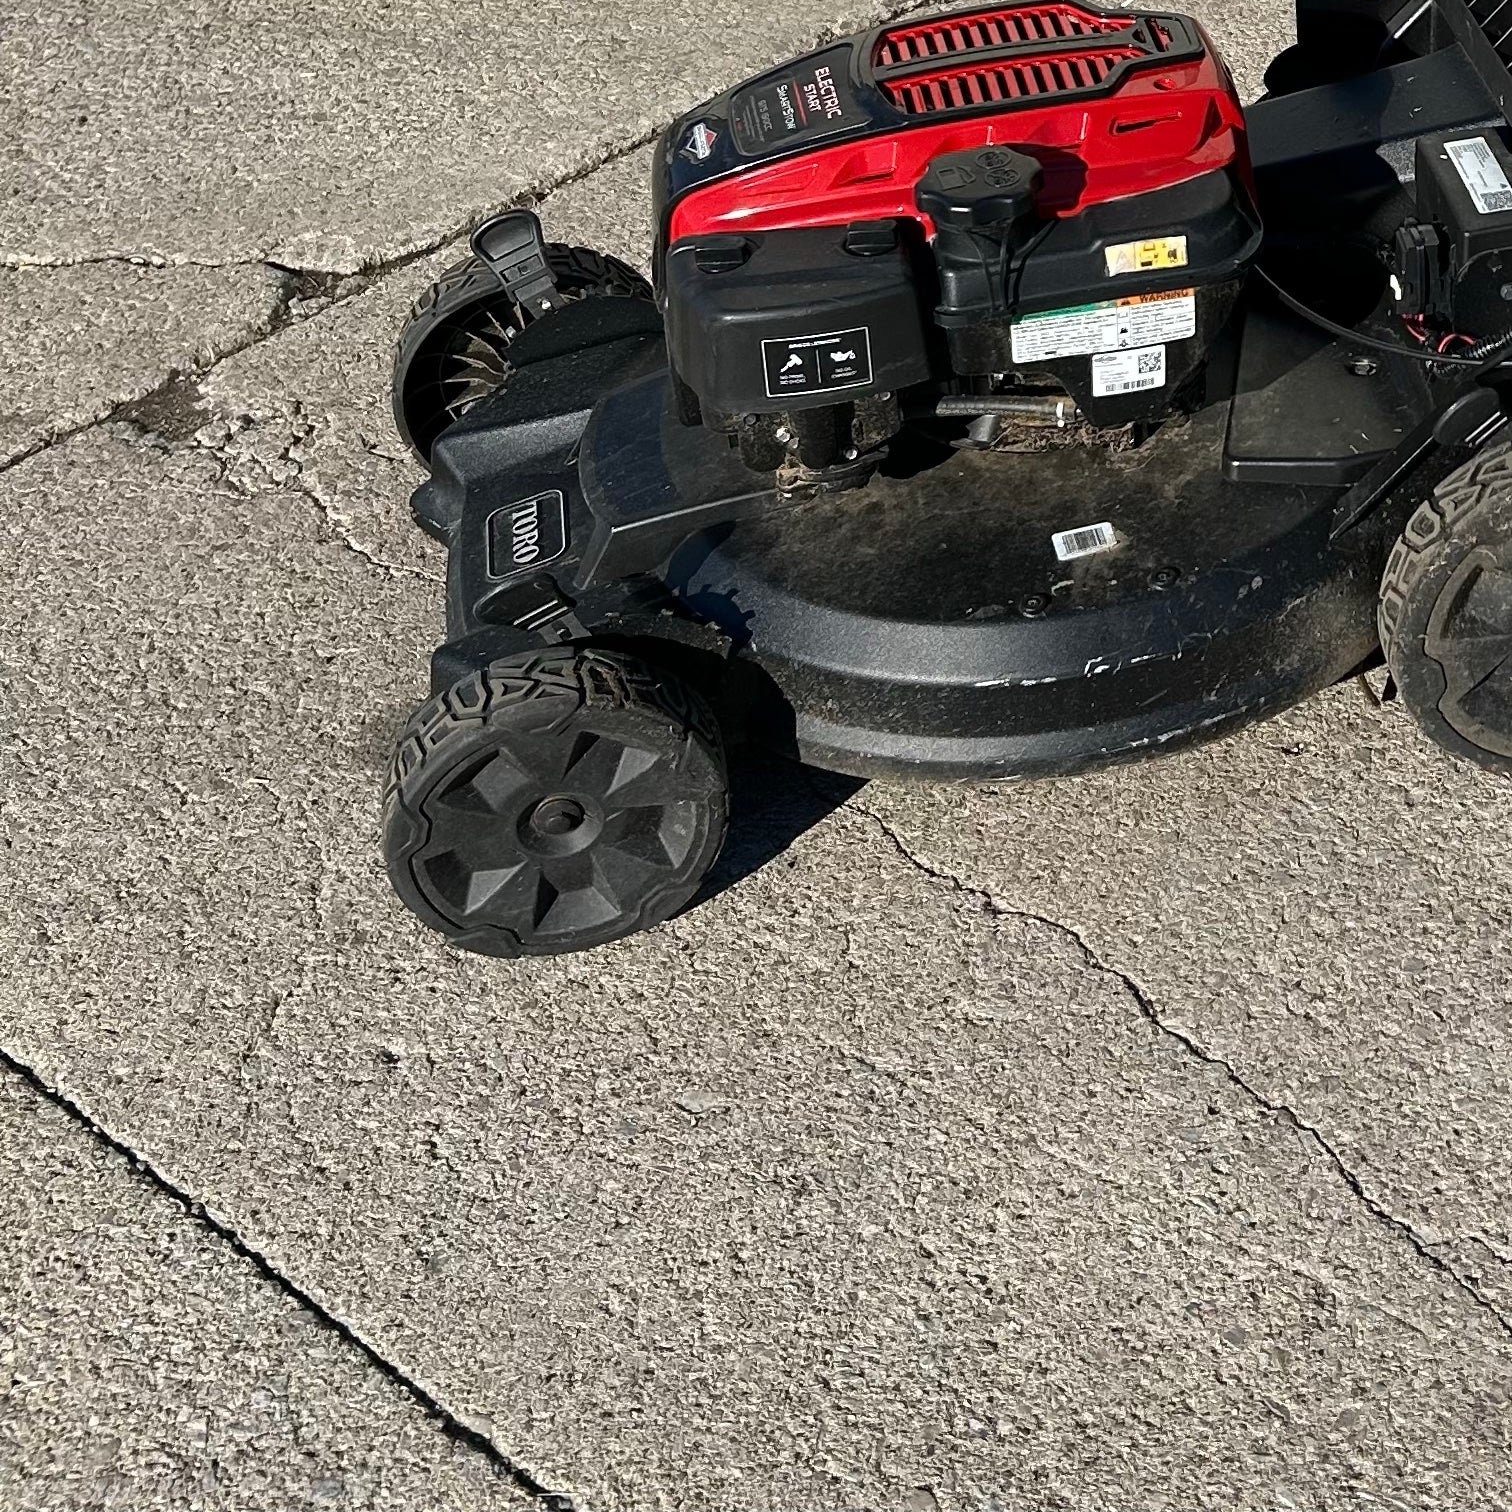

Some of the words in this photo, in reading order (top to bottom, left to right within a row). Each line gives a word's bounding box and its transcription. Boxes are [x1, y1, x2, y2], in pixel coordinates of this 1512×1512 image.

[803, 83, 822, 112] START
[815, 66, 842, 119] ELECTRIC
[512, 500, 540, 564] TORO
